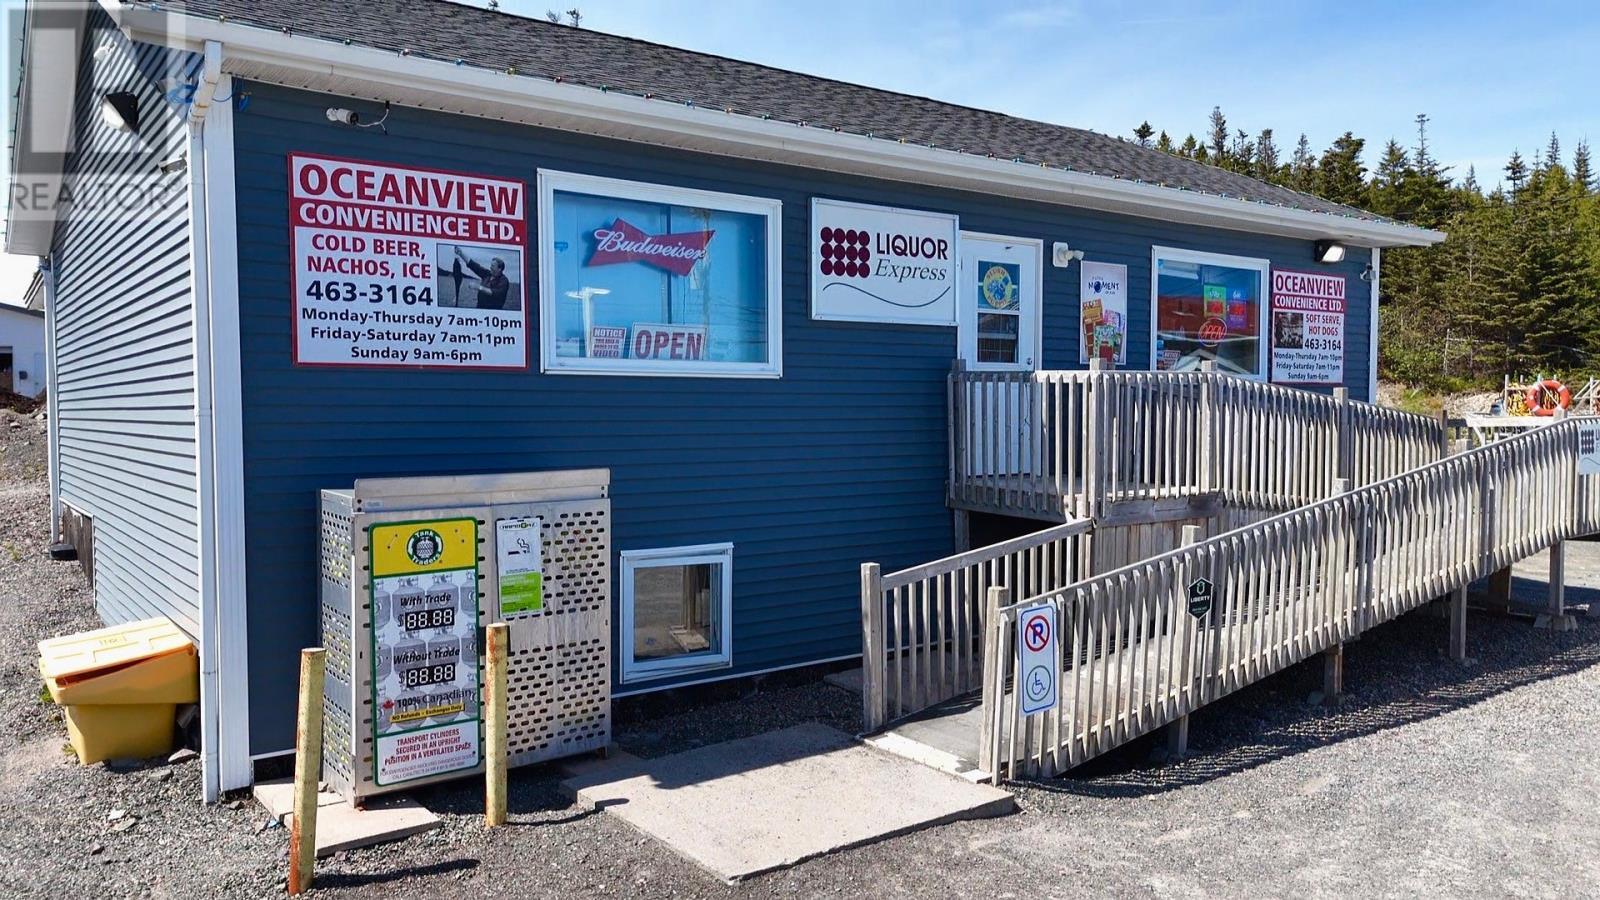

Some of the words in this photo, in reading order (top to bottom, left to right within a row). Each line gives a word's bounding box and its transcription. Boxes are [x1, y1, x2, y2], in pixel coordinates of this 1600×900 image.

[299, 163, 519, 216] OCEANVIEW
[299, 202, 470, 237] CONVENIENCE
[477, 219, 521, 242] LTD.
[312, 234, 366, 253] COLD
[373, 239, 426, 260] BEER,
[594, 229, 706, 260] Budweiser
[876, 233, 948, 260] LIQUOR
[307, 256, 395, 279] NACHOS,
[402, 263, 431, 279] ICE
[874, 259, 947, 282] Express
[306, 280, 433, 306] 463-3164
[1275, 274, 1344, 297] OCEANVIEW
[1275, 295, 1328, 311] CONVENIENCE
[1328, 300, 1344, 312] LTD.
[302, 308, 443, 327] Monday-Thursday
[447, 315, 522, 330] 7am-10pm
[1306, 314, 1321, 323] SOFT
[311, 327, 435, 345] Friday-Saturday
[440, 332, 516, 346] 7am-11pm
[1308, 325, 1321, 335] HOT
[1322, 326, 1339, 336] DOGS
[634, 330, 702, 360] OPEN
[1304, 339, 1342, 351] 463-3164
[351, 347, 409, 361] Sunday
[413, 349, 482, 362] 9am-6pm
[1274, 352, 1317, 361] Monday-Thursday
[1276, 361, 1315, 371] Friday-Saturday
[1288, 372, 1306, 380] Sunday
[411, 554, 441, 566] Traders
[400, 595, 423, 606] With
[425, 592, 452, 604] Trade
[1190, 595, 1211, 603] LIBERTY
[393, 651, 432, 664] Without
[434, 647, 460, 659] Trade
[396, 698, 420, 708] 100%
[421, 689, 472, 704] Canadian
[395, 745, 421, 755] SECURED
[429, 741, 437, 749] AN
[438, 736, 461, 747] UPRIGHT
[396, 734, 429, 746] TRANSPORT
[430, 728, 460, 740] CYLINDERS
[411, 752, 417, 760] IN
[423, 745, 454, 758] VENTILATED
